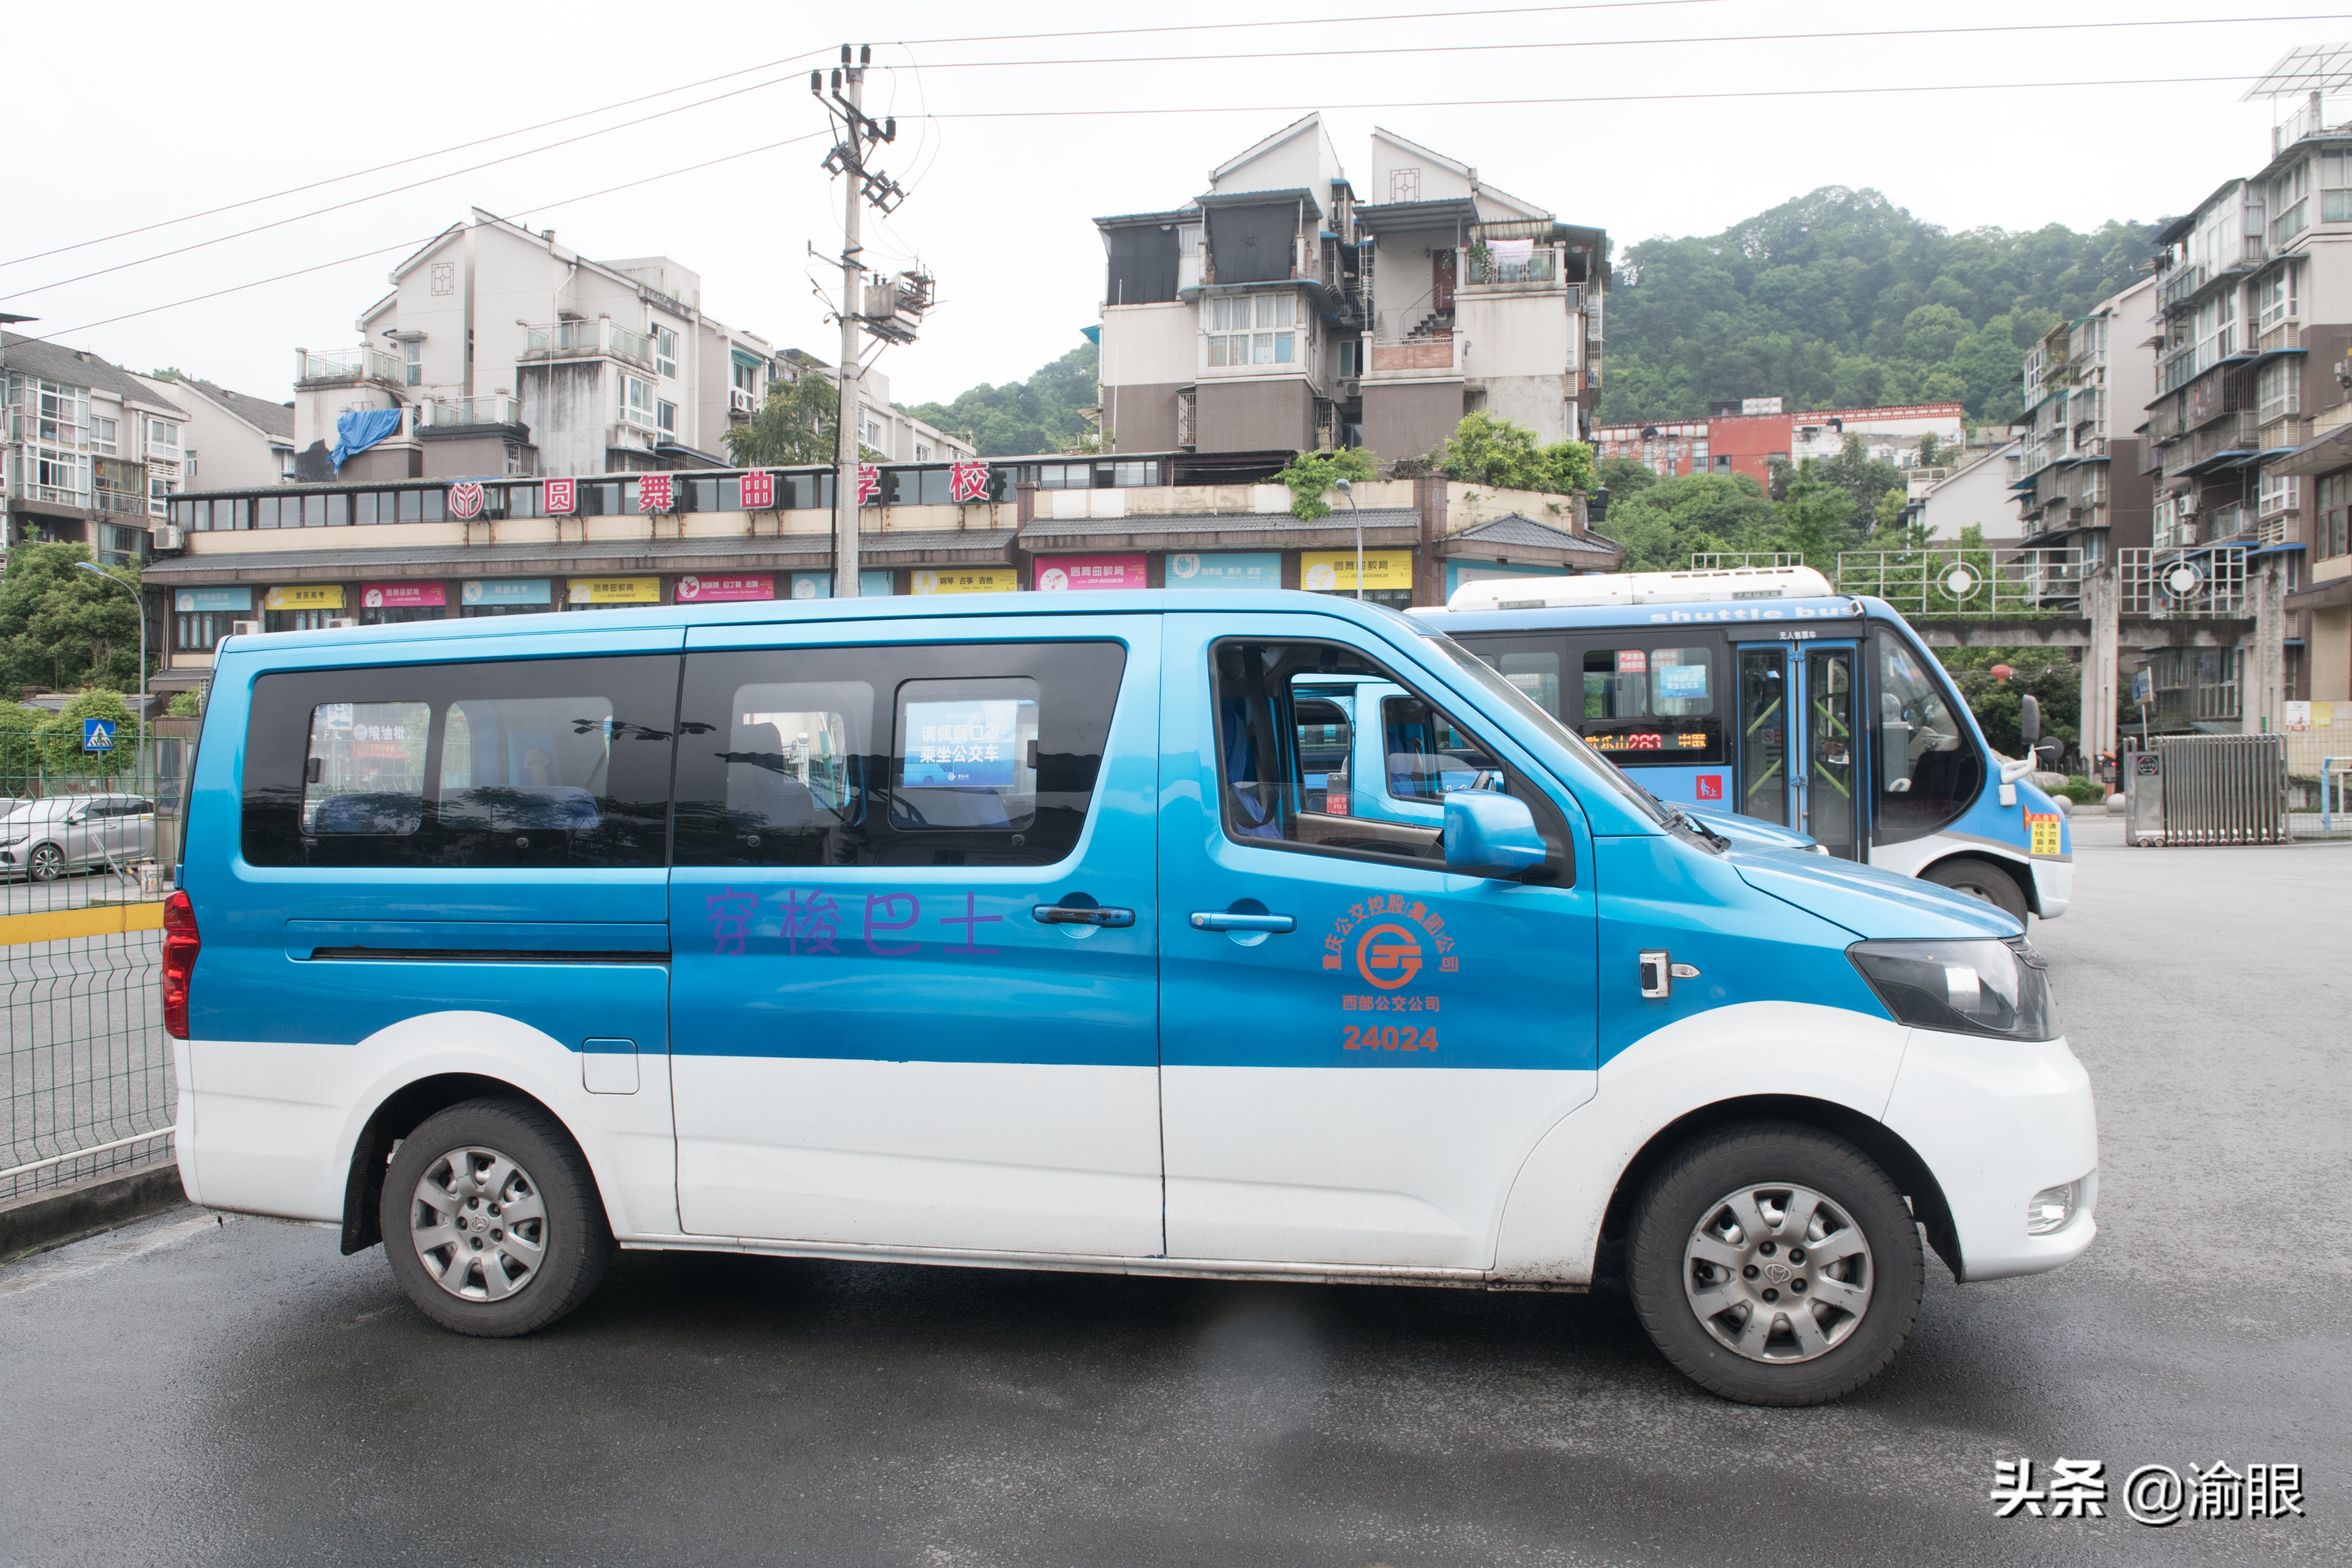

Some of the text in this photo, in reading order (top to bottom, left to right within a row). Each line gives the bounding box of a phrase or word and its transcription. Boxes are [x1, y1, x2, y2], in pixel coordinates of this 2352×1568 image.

[1071, 566, 1124, 577] 圆舞曲教育
[1650, 606, 1853, 622] shuttle bus
[1779, 631, 1816, 639] 无人售票车
[368, 725, 411, 741] 粮油批
[921, 724, 1001, 743] 请佩戴口罩
[920, 744, 999, 763] 乘坐公交车
[705, 885, 1003, 957] 穿梭巴士
[1342, 995, 1440, 1012] 西部公交公司
[1342, 1025, 1439, 1052] 24024
